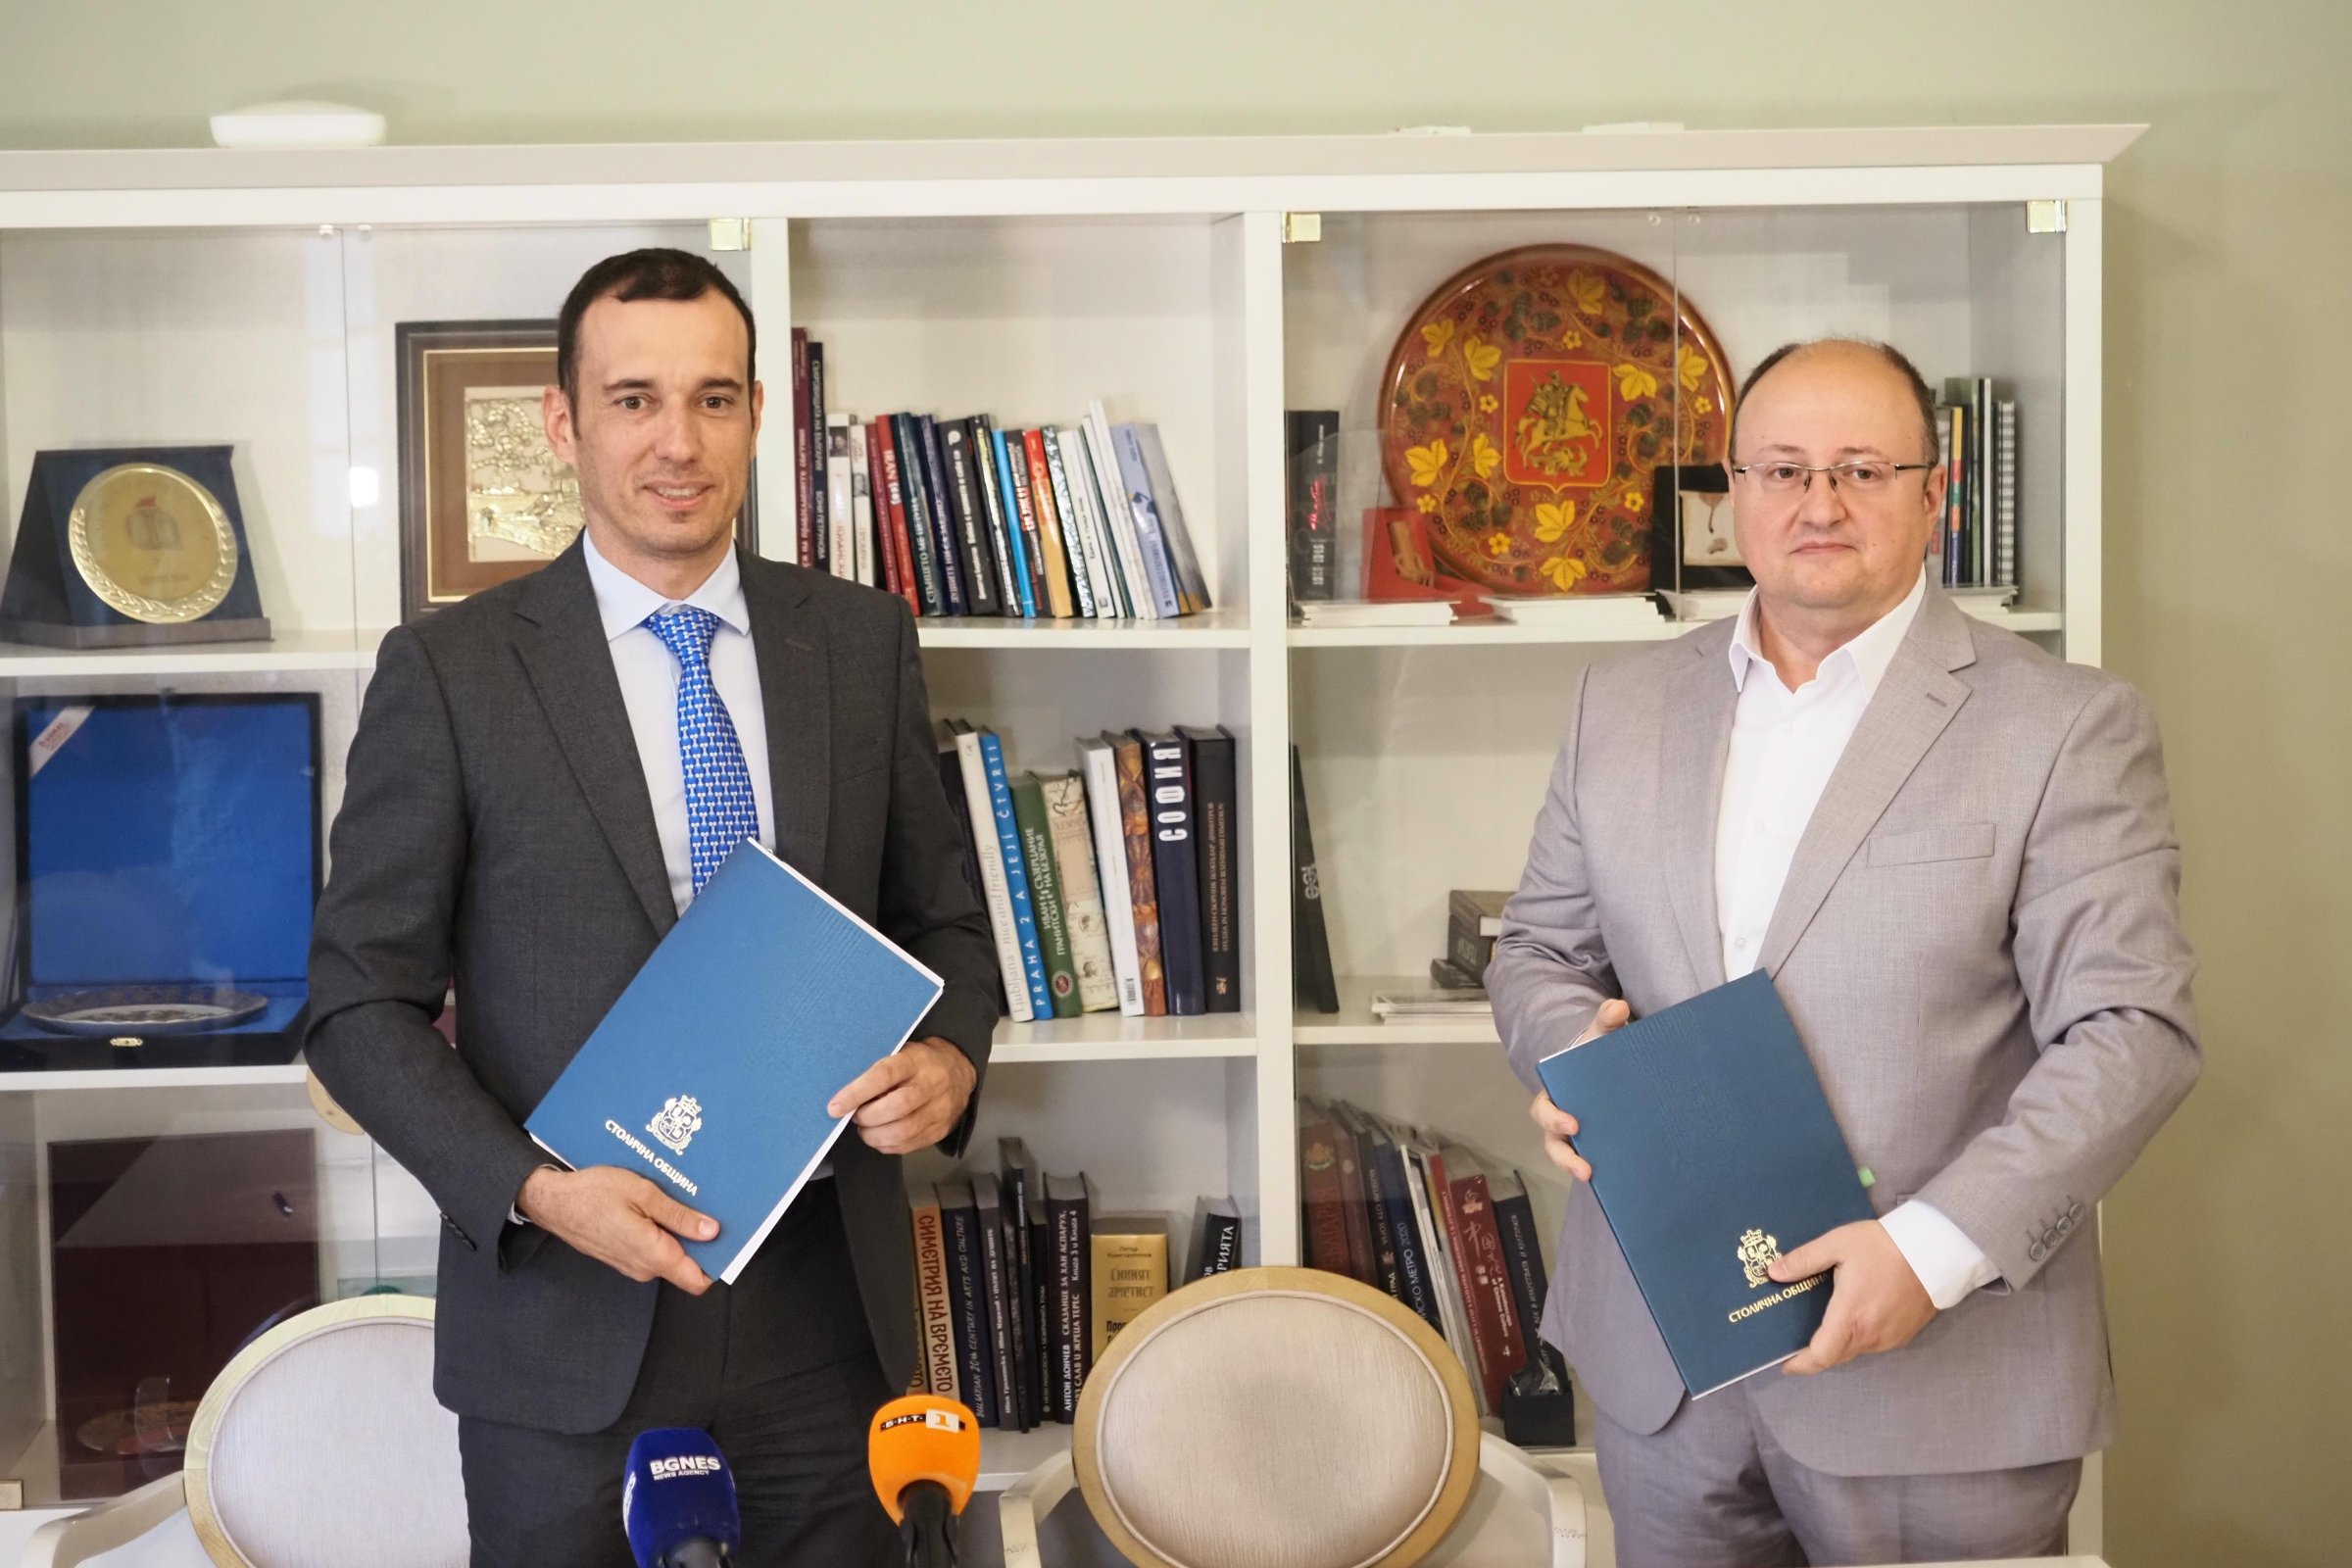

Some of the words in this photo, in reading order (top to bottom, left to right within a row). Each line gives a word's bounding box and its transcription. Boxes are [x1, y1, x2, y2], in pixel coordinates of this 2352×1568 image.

[988, 745, 1010, 818] ČTVRTI
[1152, 748, 1188, 841] СОФИЯ
[1005, 833, 1021, 874] JEJÍ
[1025, 827, 1044, 890] СЪЗЕРЦАНИЕ
[1035, 834, 1050, 871] БЕЗКРАЯ
[982, 844, 1004, 893] friendly
[1043, 872, 1053, 887] НА
[994, 894, 1005, 917] and
[1015, 890, 1026, 900] A
[1041, 901, 1052, 929] ИВАН
[1049, 900, 1065, 956] ГРАНИТСКИ
[1000, 919, 1010, 945] nice
[1004, 955, 1025, 1012] Ljubljana
[1025, 939, 1045, 1005] PRAHA
[606, 1119, 655, 1163] СТОЛИЧНА
[655, 1157, 698, 1197] ОБЩИНА
[954, 1214, 966, 1252] CULTURE
[1377, 1221, 1389, 1245] SOFIA
[1397, 1223, 1411, 1247] 2020
[917, 1215, 943, 1297] СИМЕТРИЯ
[958, 1254, 969, 1273] AND
[1059, 1254, 1068, 1274] ХАН
[1216, 1226, 1235, 1274] РИЯТА
[1060, 1276, 1069, 1287] ЗА
[1403, 1250, 1420, 1285] МЕТРО
[961, 1274, 972, 1298] ARTS
[1388, 1272, 1396, 1297] ГРАД
[927, 1299, 947, 1321] НА
[963, 1298, 973, 1309] IN
[1061, 1290, 1070, 1335] СКАЗАНИЕ
[1729, 1293, 1783, 1323] СТОЛИЧНА
[964, 1310, 978, 1349] CENTURY
[1072, 1322, 1081, 1351] ЖРЕЦА
[930, 1323, 954, 1393] ВРЕМЕТО
[1062, 1345, 1071, 1380] ДОНЧЕВ
[1063, 1382, 1072, 1411] АНТОН
[650, 1456, 721, 1476] BGNES
[653, 1471, 677, 1481] NEWS
